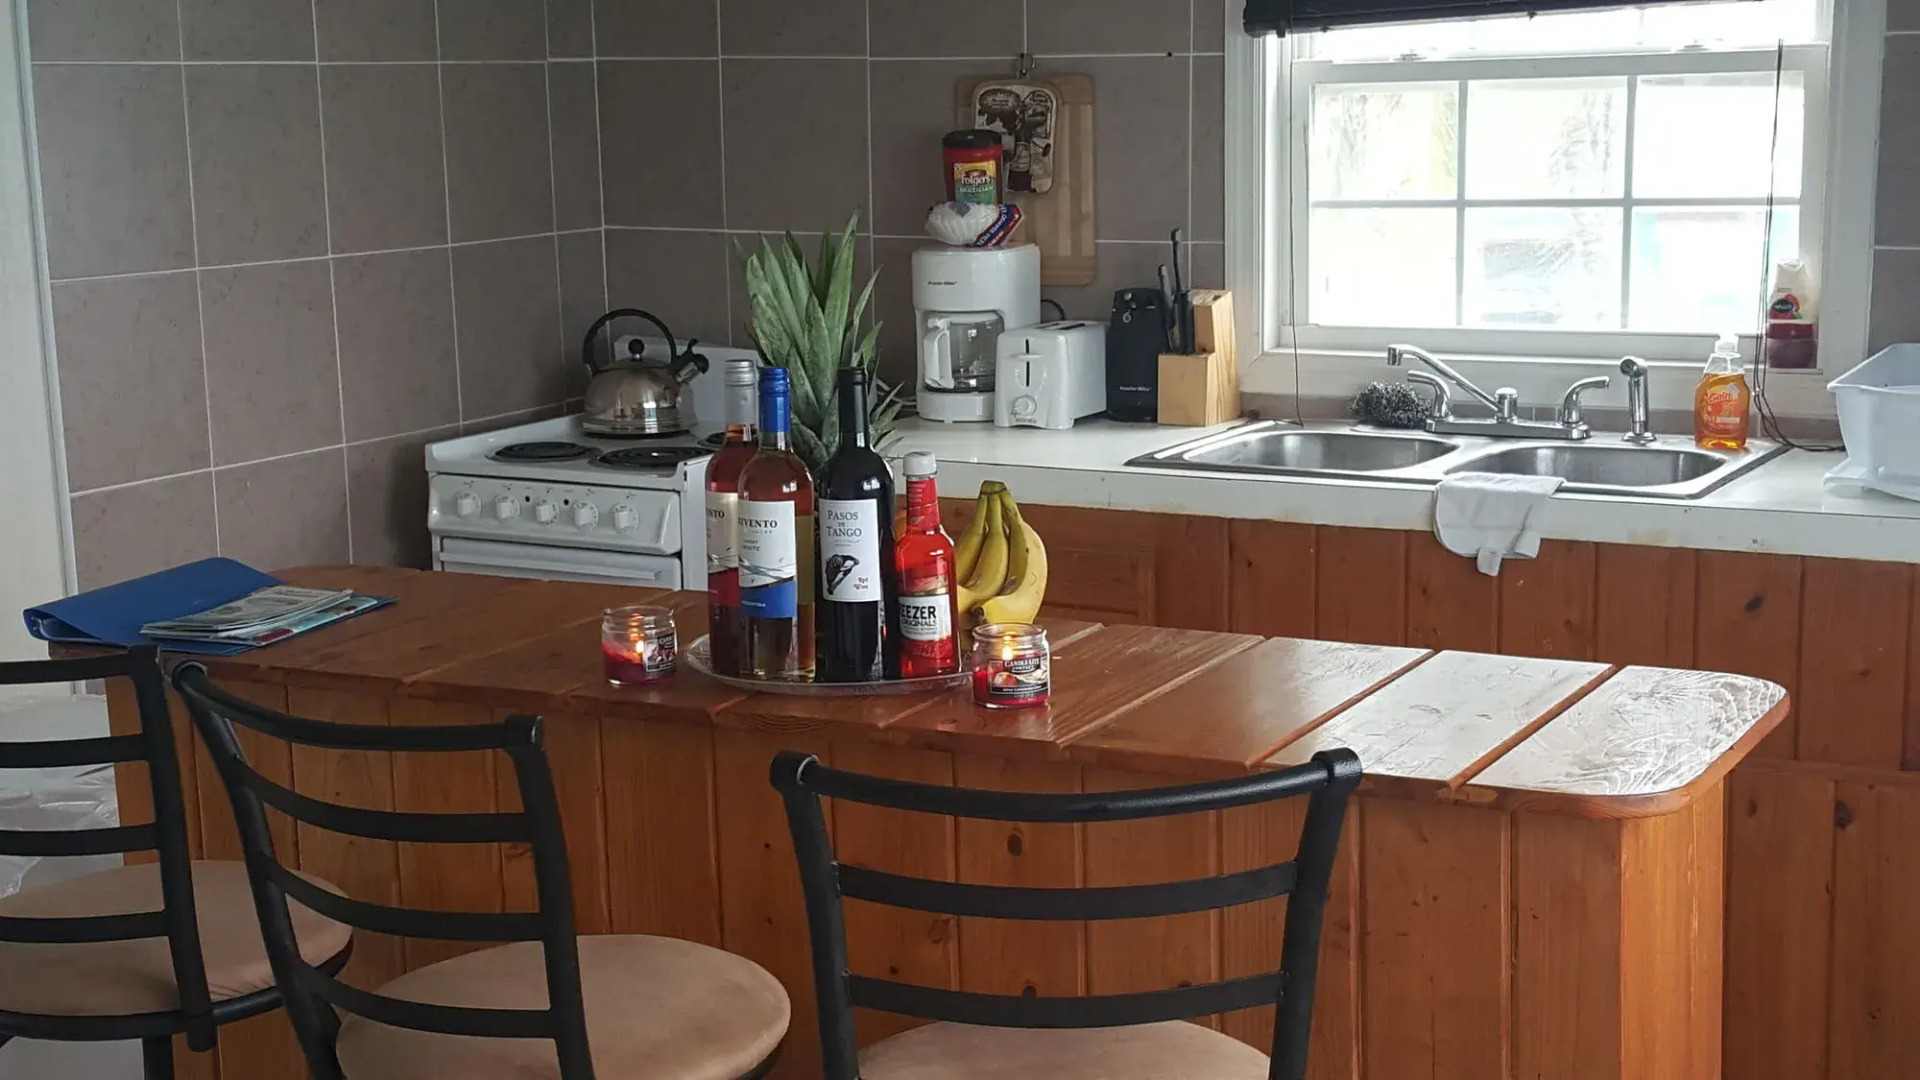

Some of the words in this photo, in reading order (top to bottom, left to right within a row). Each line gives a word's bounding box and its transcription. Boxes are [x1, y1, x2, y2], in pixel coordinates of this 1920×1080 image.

[961, 173, 991, 186] Folgers
[1709, 392, 1730, 402] Gain
[827, 510, 859, 521] PASOS
[826, 526, 862, 537] TANGO
